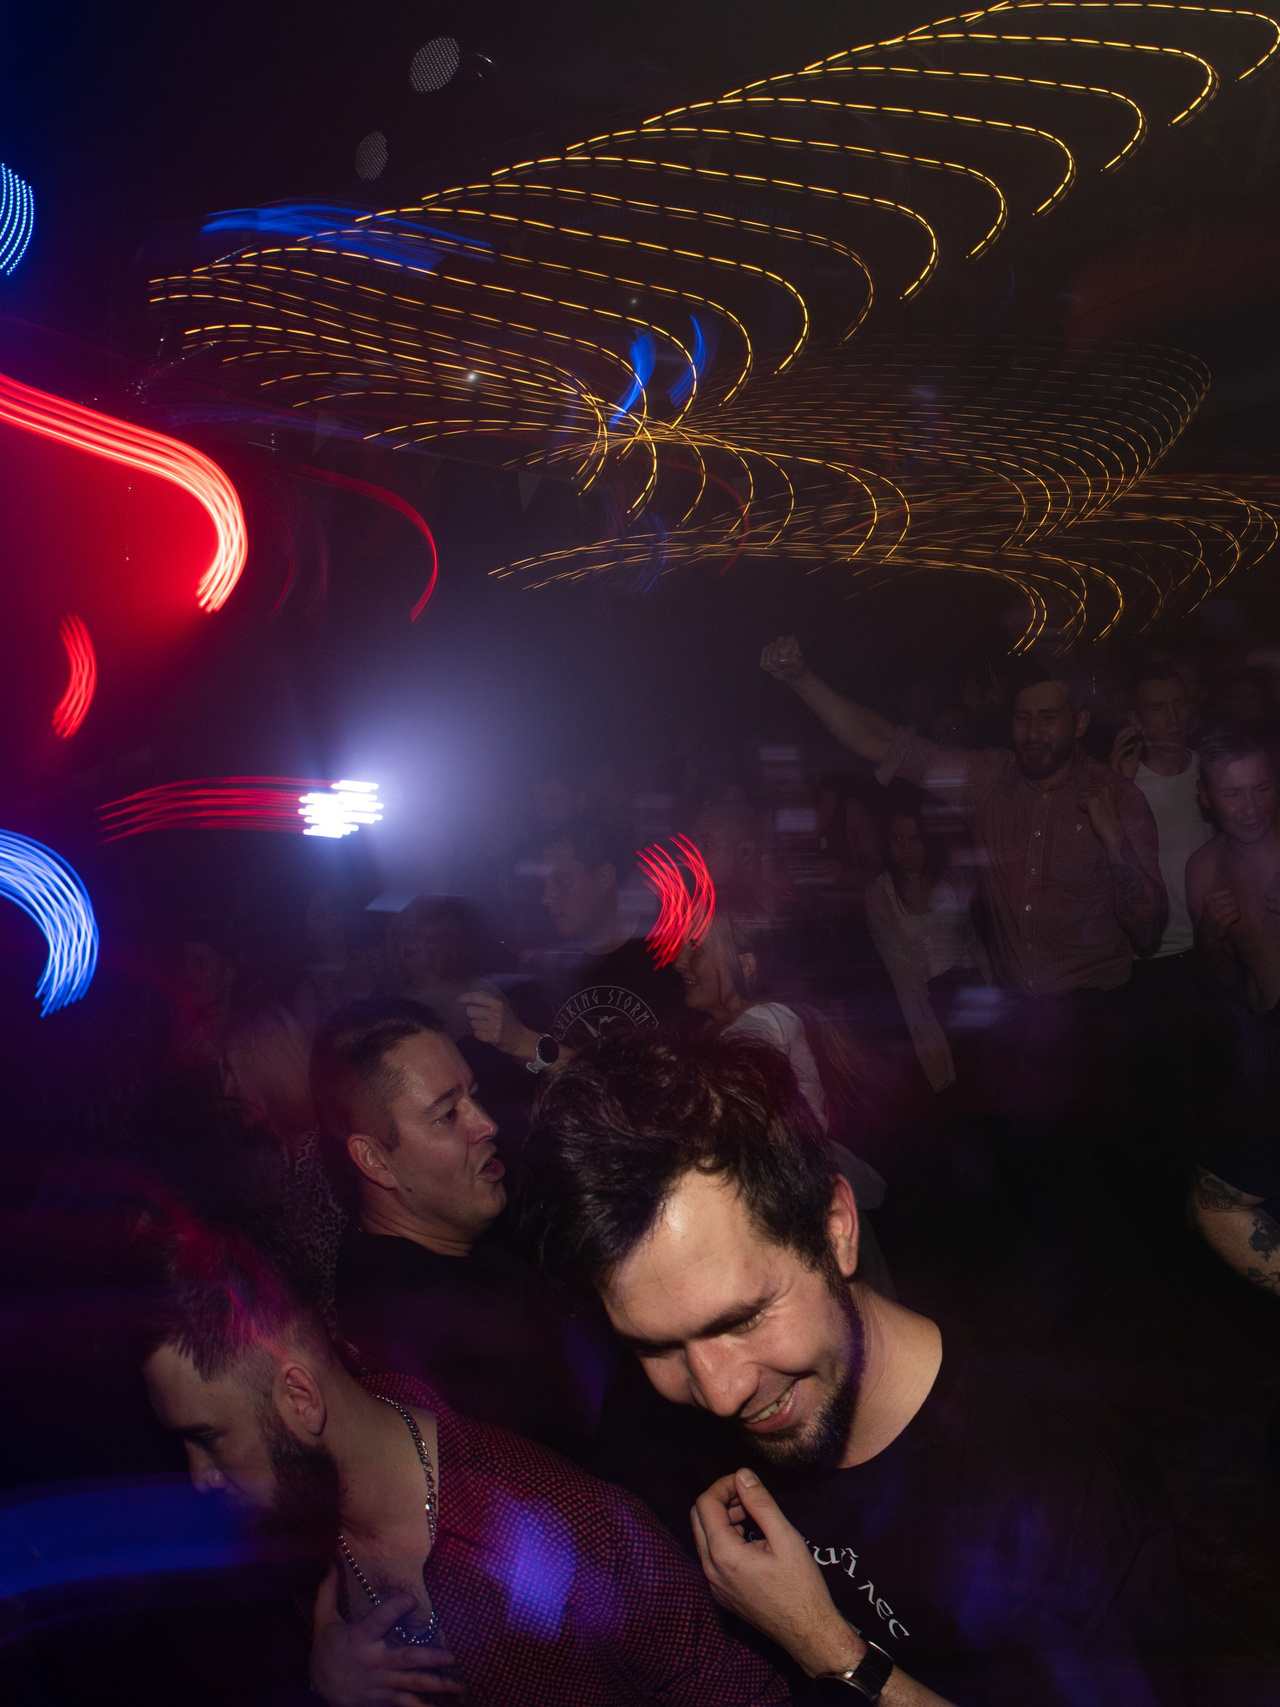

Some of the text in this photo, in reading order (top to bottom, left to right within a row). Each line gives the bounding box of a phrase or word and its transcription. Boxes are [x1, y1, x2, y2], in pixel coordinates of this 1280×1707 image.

[555, 989, 650, 1030] VIKING STORM
[858, 1580, 910, 1639] лес
